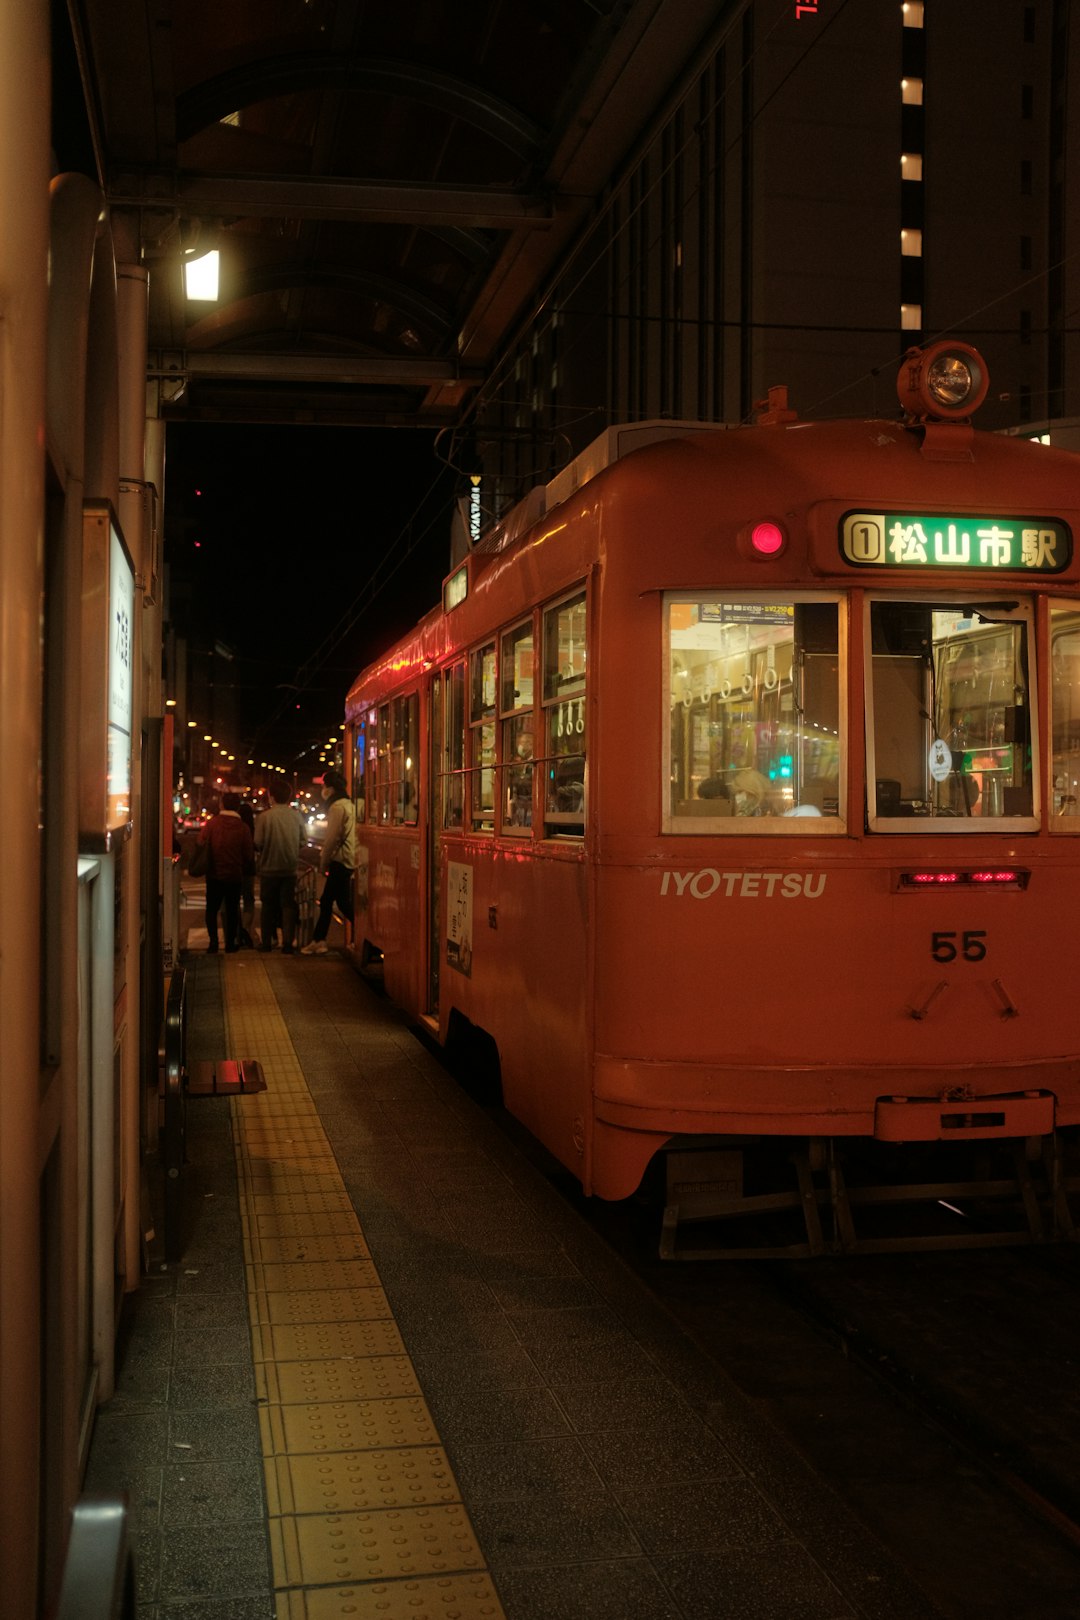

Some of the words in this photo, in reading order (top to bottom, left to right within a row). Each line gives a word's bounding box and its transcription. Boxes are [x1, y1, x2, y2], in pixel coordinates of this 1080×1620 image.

[889, 521, 1057, 567] 松山市駅
[660, 868, 827, 899] IYOTETSU
[932, 930, 987, 963] 55
